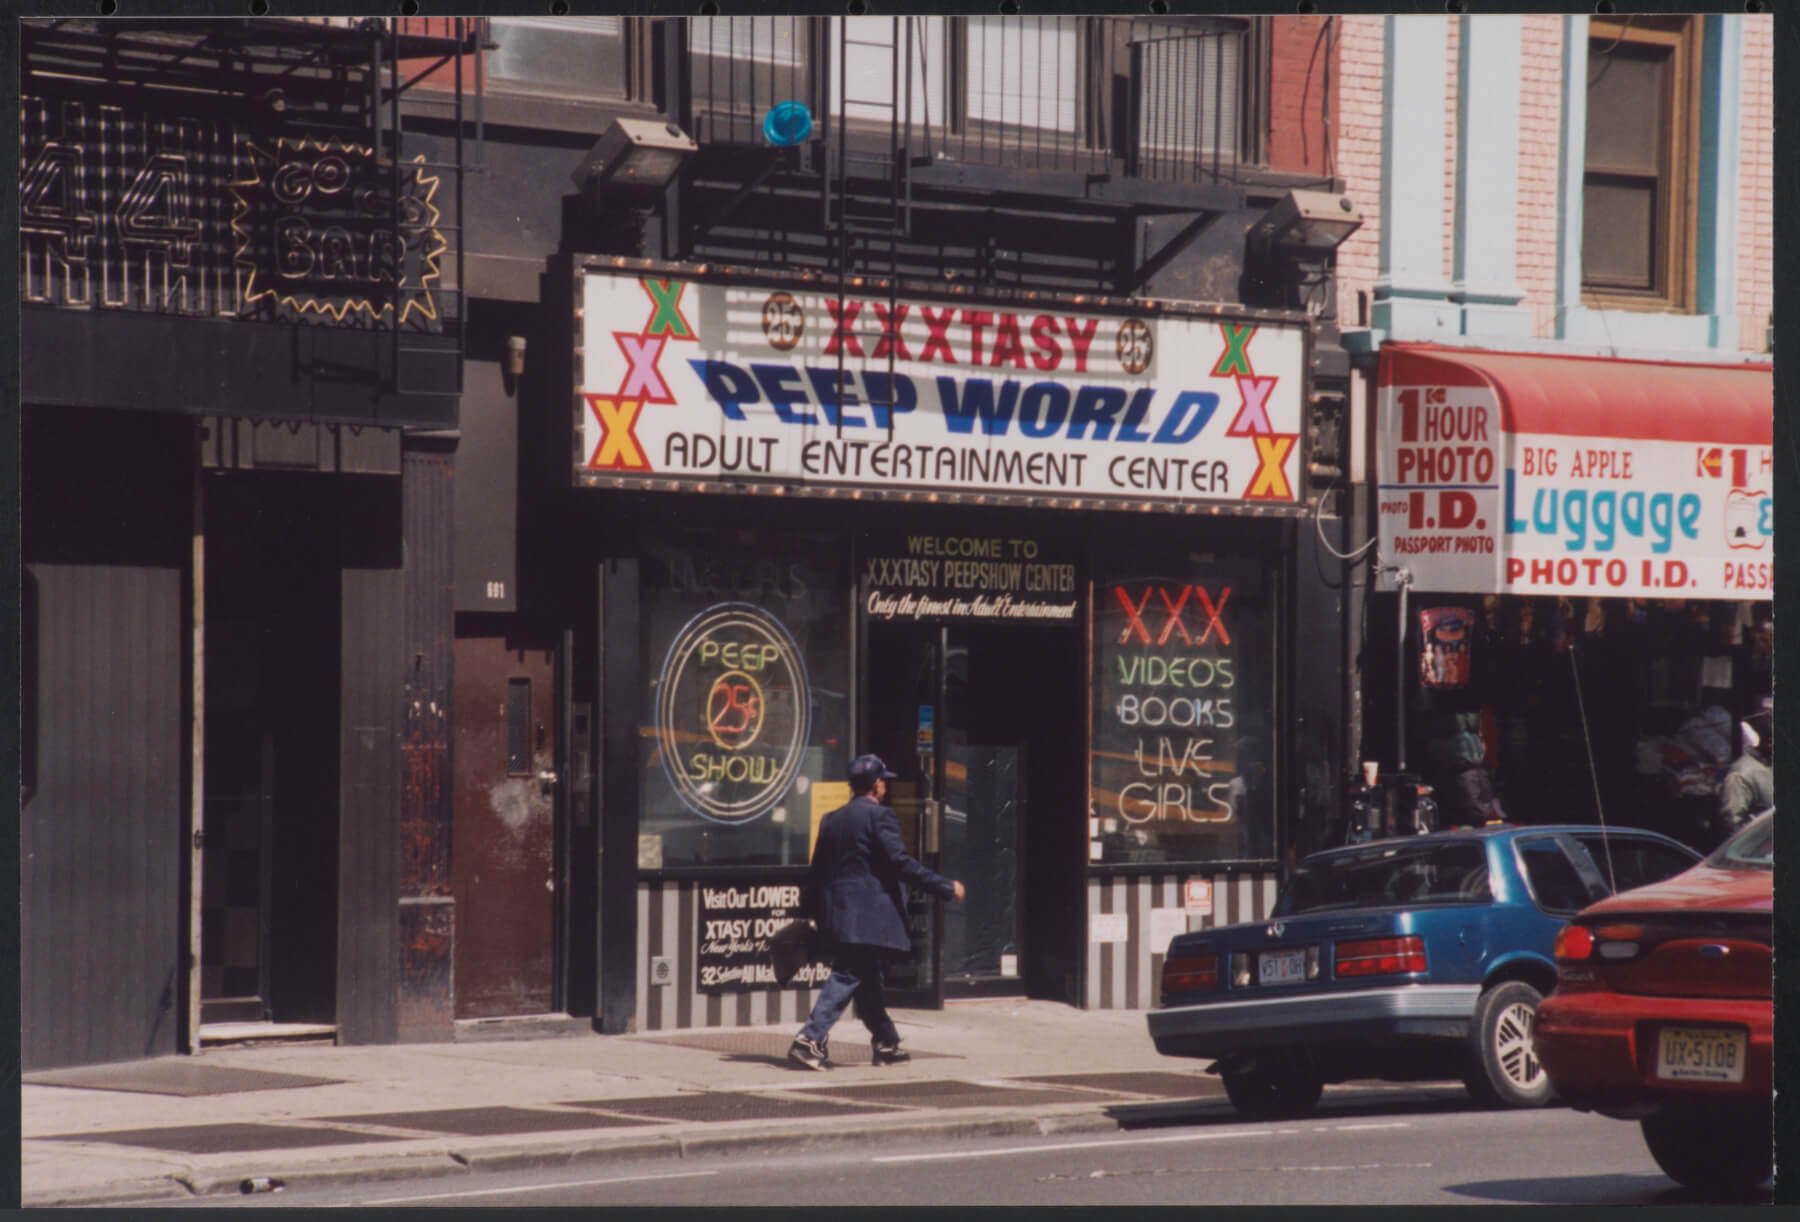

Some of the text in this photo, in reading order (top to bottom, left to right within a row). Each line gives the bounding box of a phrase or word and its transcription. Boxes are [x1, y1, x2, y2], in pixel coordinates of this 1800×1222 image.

[823, 298, 1100, 374] XXXTASY
[686, 357, 1221, 445] PEEP WORLD
[1424, 406, 1488, 442] HOUR
[664, 431, 1229, 493] ADULT ENTERTAINMENT CENTER
[1396, 447, 1494, 484] PHOTO
[1522, 448, 1633, 479] BIG APPLE
[1408, 490, 1487, 530] I.D.
[1505, 488, 1702, 553] Luggage
[907, 536, 1039, 560] WELCOME TO
[1394, 537, 1494, 554] PASSPORT PHOTO
[867, 558, 1075, 593] XXXTASY PEEPSHOW CENTER
[1507, 558, 1773, 590] PHOTO I.D. PASS
[1114, 584, 1233, 647] XXX
[700, 639, 780, 671] PEEP
[1118, 655, 1235, 688] VIDEOS
[1116, 694, 1234, 728] BOOKS
[690, 753, 778, 784] SHOW
[1134, 736, 1214, 778] LIVE
[1118, 781, 1234, 824] GIRLS
[703, 885, 801, 909] Visit Our LOWER
[705, 919, 753, 940] XTASY
